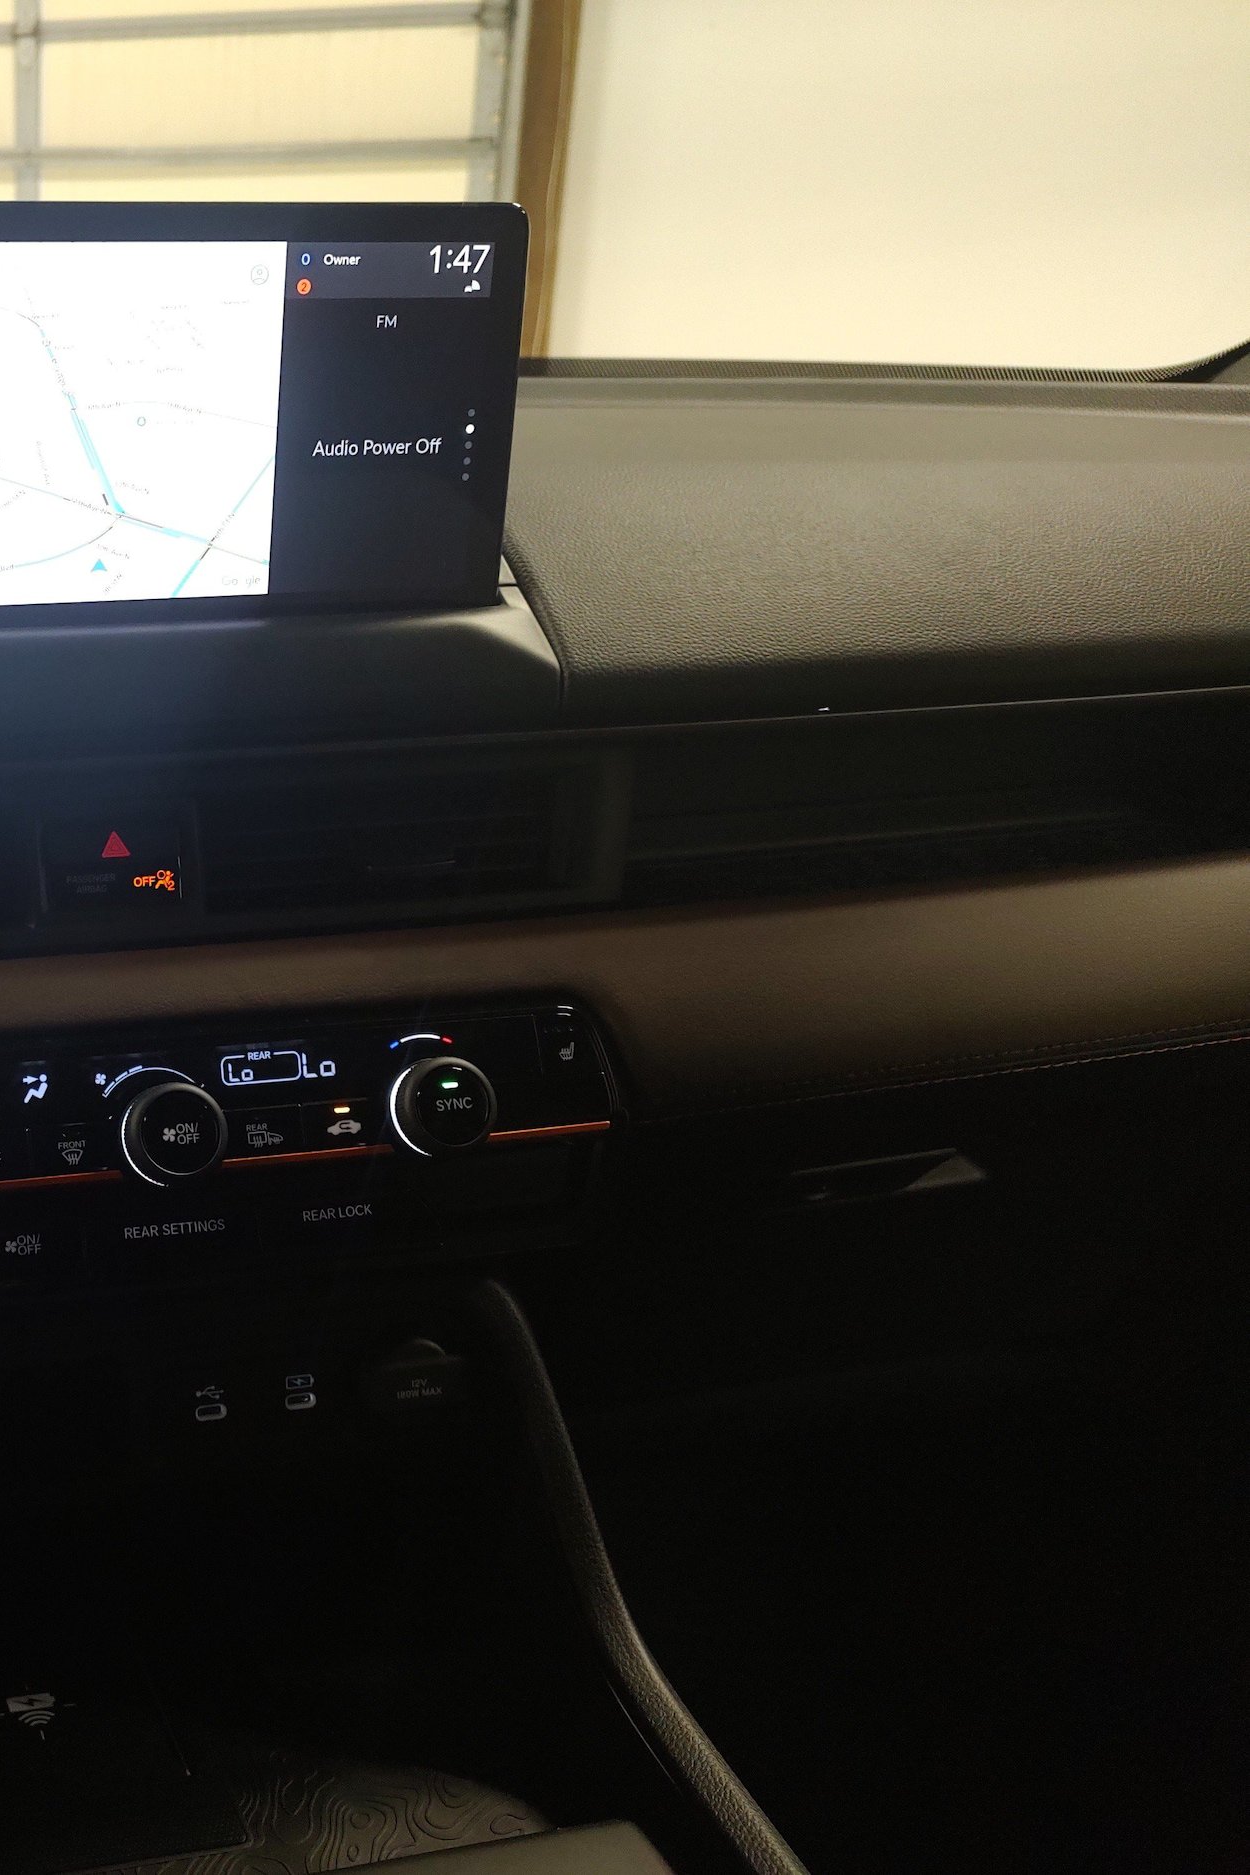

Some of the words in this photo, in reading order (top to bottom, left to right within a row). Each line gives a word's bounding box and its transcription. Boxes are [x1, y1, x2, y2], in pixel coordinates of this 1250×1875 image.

[323, 254, 361, 266] Owner
[429, 244, 491, 274] 1:47
[301, 282, 308, 292] 2
[376, 315, 398, 328] FM
[312, 440, 359, 457] Audio
[363, 439, 411, 455] Power
[415, 437, 443, 454] Off
[221, 575, 261, 589] Gogle
[133, 876, 156, 888] OFF
[247, 1051, 271, 1061] REAR
[436, 1096, 473, 1112] SYNC
[176, 1122, 199, 1134] ON/
[246, 1123, 268, 1132] REAR
[58, 1140, 86, 1150] FRONT
[177, 1133, 200, 1145] OFF
[303, 1208, 335, 1222] REAR
[338, 1204, 373, 1219] LOCK
[124, 1225, 159, 1240] REAR
[162, 1219, 225, 1236] SETTINGS
[17, 1234, 41, 1246] ON/
[17, 1244, 42, 1256] OFF
[411, 1378, 428, 1388] 12V
[421, 1387, 443, 1396] MAX
